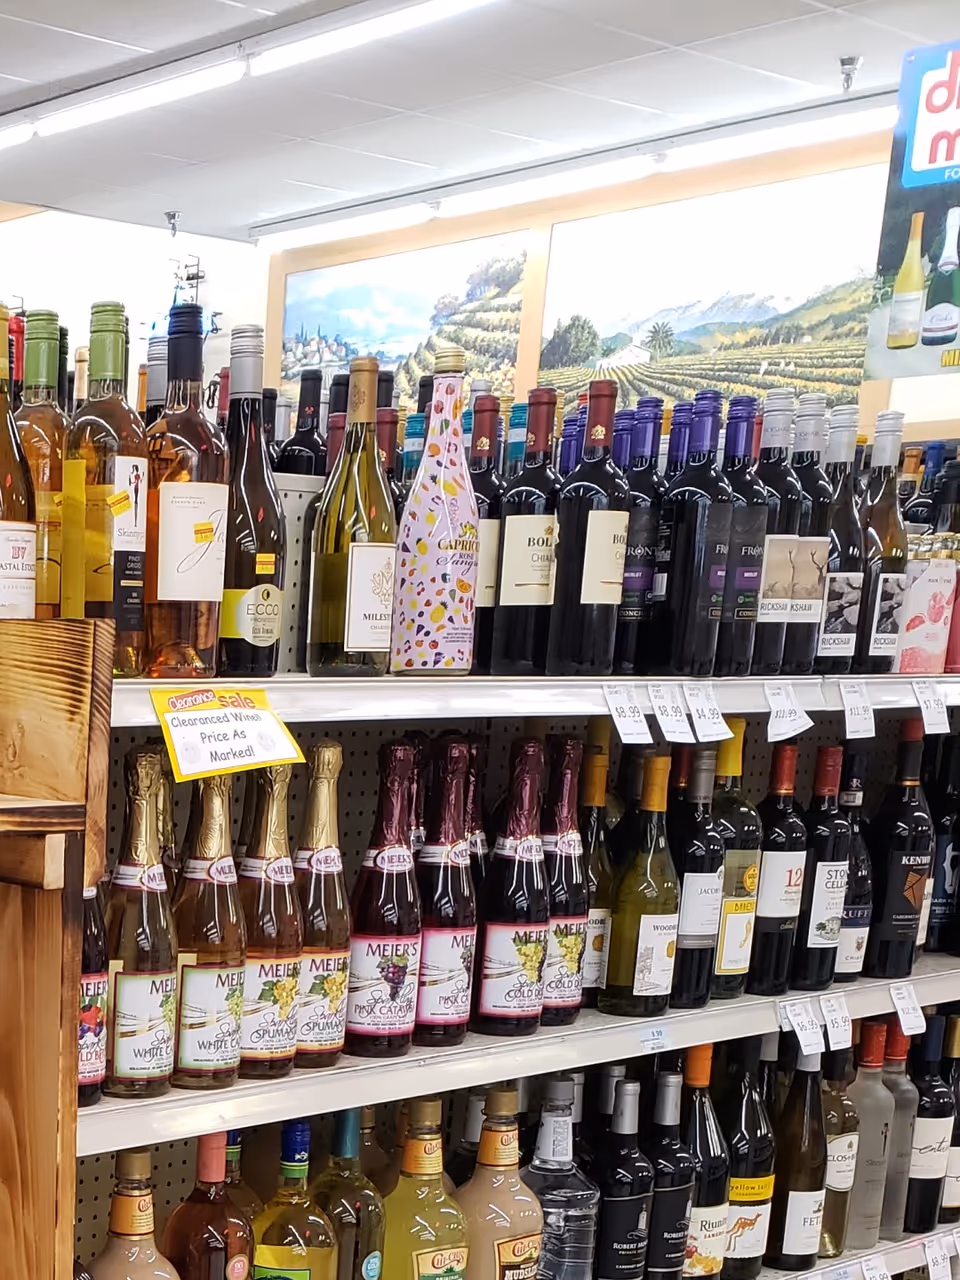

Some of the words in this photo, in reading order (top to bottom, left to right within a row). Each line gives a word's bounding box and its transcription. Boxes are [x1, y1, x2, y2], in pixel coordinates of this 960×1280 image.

[925, 49, 960, 114] d
[246, 603, 279, 616] ECCO
[168, 689, 216, 711] Clearance
[217, 692, 257, 710] sale
[615, 705, 641, 719] $8.99
[658, 705, 683, 718] $8.99
[695, 707, 720, 720] $4.99
[170, 713, 230, 728] Clearanced
[200, 730, 230, 744] Price
[233, 729, 247, 740] As
[209, 745, 255, 763] Marked!
[786, 868, 802, 888] 12
[366, 942, 418, 957] MEIER'S
[830, 1016, 851, 1029] $5.99
